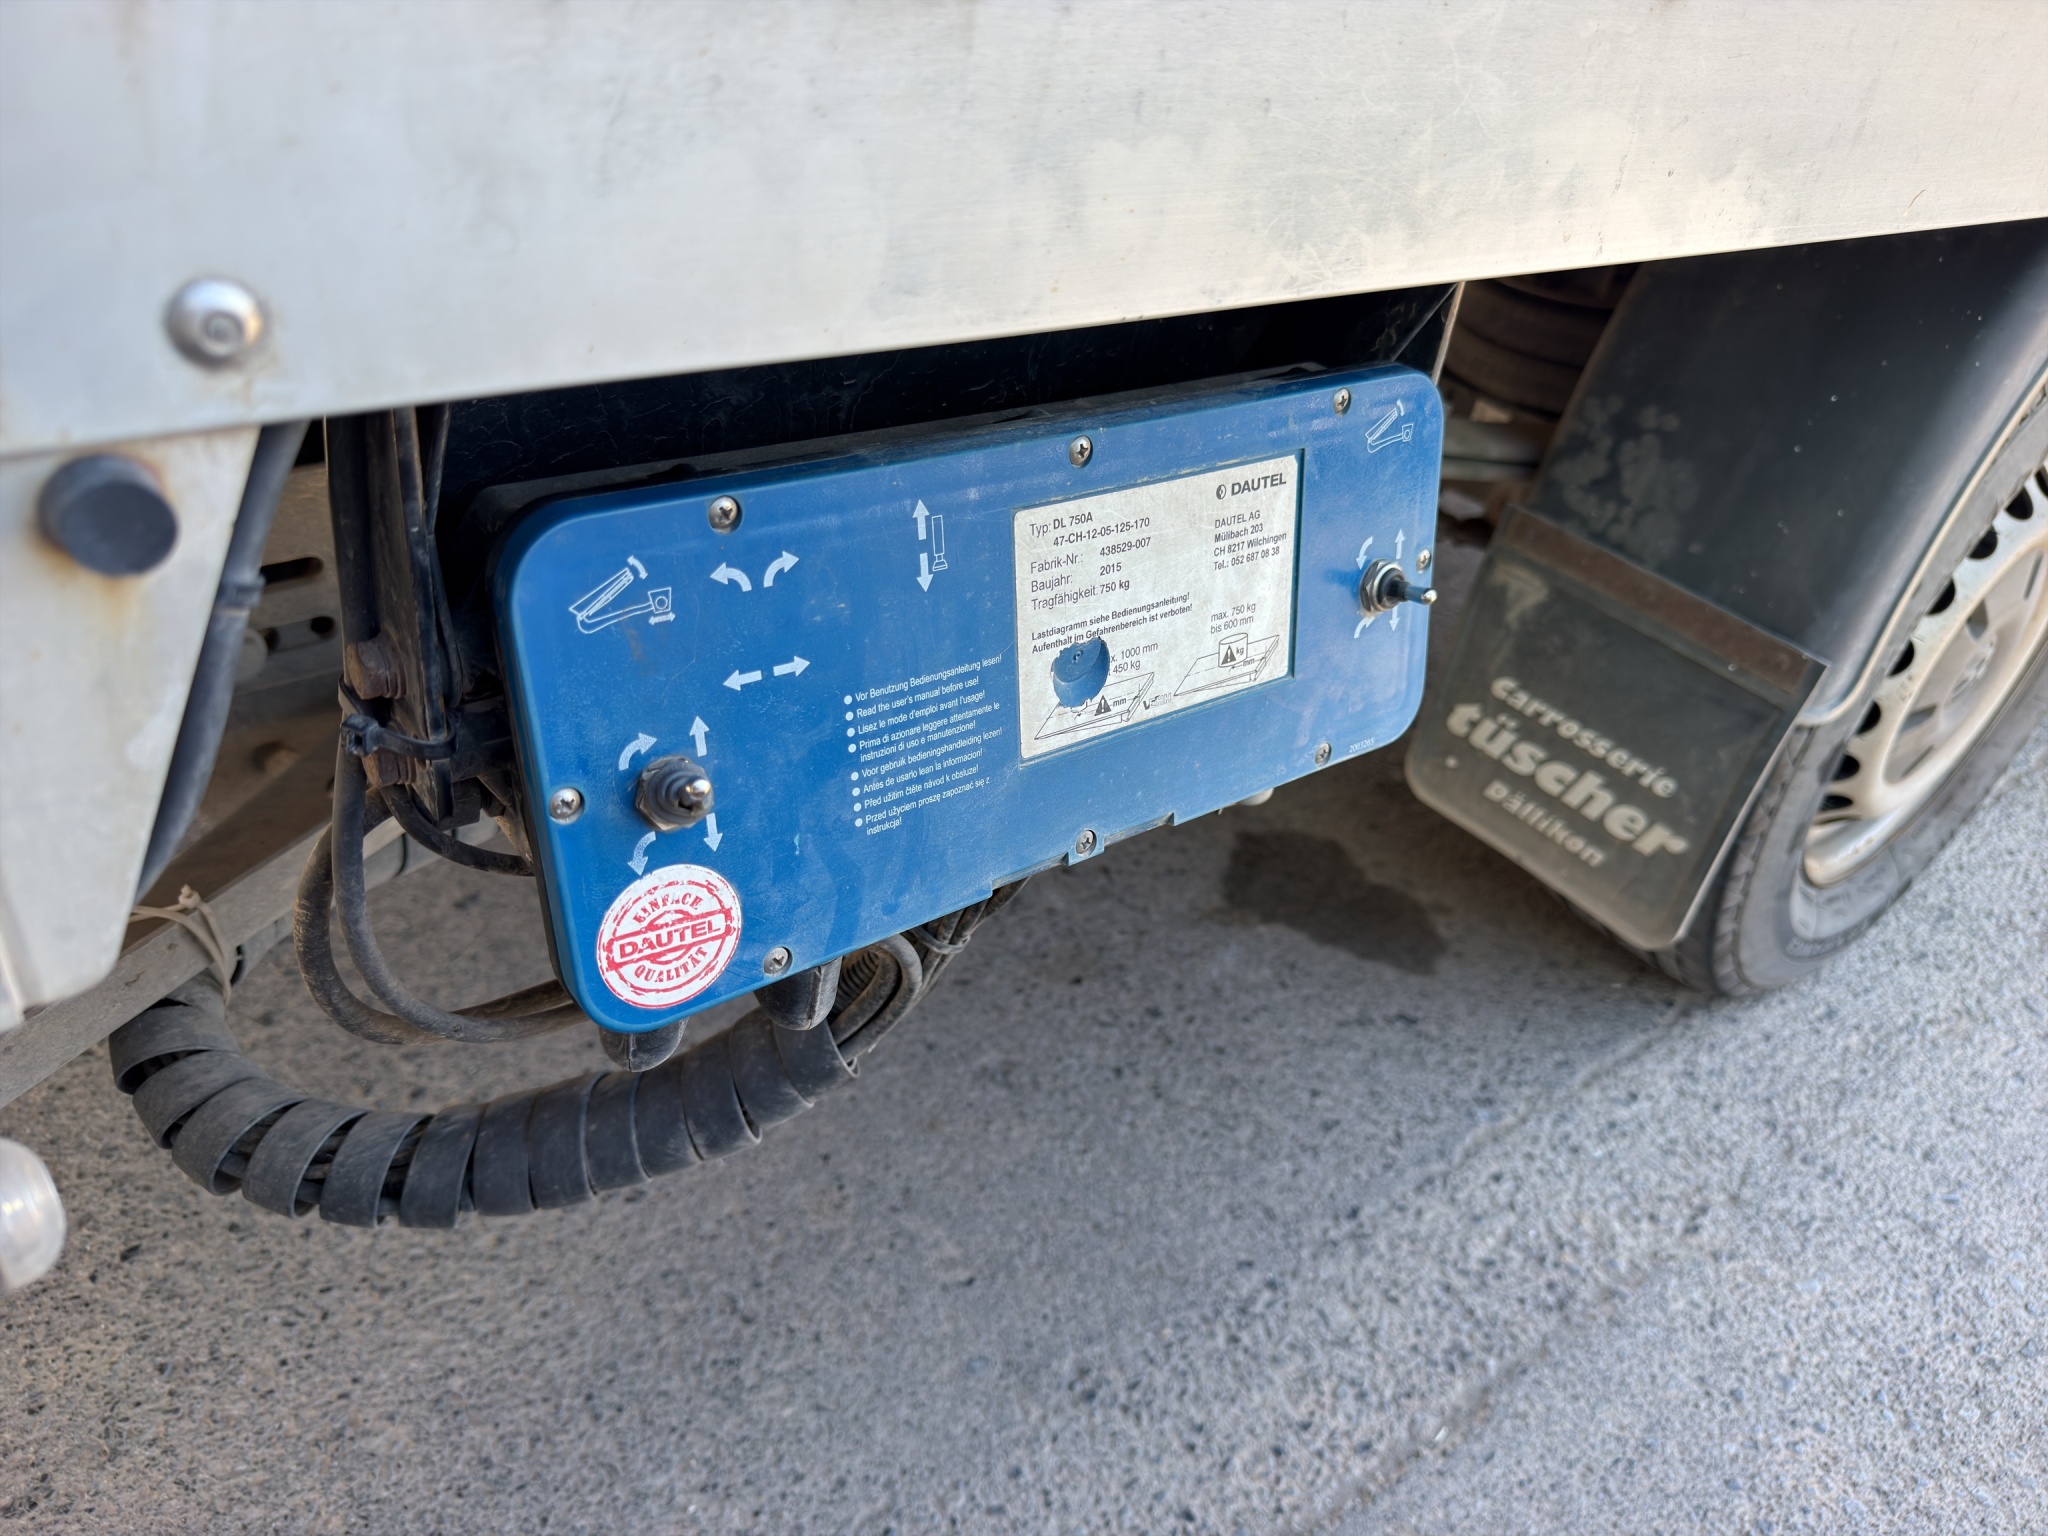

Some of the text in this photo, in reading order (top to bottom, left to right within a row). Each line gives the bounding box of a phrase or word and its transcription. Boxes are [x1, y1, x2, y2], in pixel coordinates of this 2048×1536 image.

[1231, 473, 1287, 496] DAUTEL
[1030, 511, 1093, 538] Typ: DL 750A
[1053, 517, 1150, 547] 47-CH-12-05-125-170
[1214, 523, 1263, 543] Mülibach 203
[1215, 510, 1260, 529] DAUTEL AG
[1030, 537, 1151, 574] Fabrik-Nr.: 438529-007
[1214, 533, 1287, 557] CH 8217 Wilchingen
[1214, 546, 1280, 570] Tel.: 052 687 08 38
[1031, 562, 1122, 593] Baujahr: 2015
[1032, 579, 1130, 611] Tragfähigkeit: 750 kg
[1032, 592, 1190, 641] Lastdiagramm siehe Bedienungsanleitung!
[1210, 603, 1256, 622] max. 750 kg
[1210, 616, 1254, 634] bis 600 mm
[1032, 604, 1193, 654] Aufenthalt im Gefahrenbereich ist verboten!
[1121, 647, 1140, 660] 1000
[1142, 642, 1158, 654] mm
[1236, 646, 1245, 655] kg
[855, 654, 1002, 702] Vor Benutzung Bedienungsanleitung lesen!
[1113, 661, 1129, 674] 450
[1130, 659, 1141, 670] kg
[857, 676, 979, 718] Read the user's manual before use!
[1112, 697, 1127, 708] mm
[858, 690, 985, 735] Lisez le mode d'emploi avant l'usage!
[860, 702, 1000, 751] Prima di azionare leggere attentamente le
[860, 745, 897, 763] instruzioni
[898, 742, 905, 751] di
[906, 738, 919, 749] uso
[927, 720, 976, 742] manutenzione!
[861, 727, 1003, 778] Voor gebruik bedieningshandleiding lezen!
[863, 781, 884, 794] Antes
[886, 777, 895, 786] de
[919, 765, 933, 776] lean
[935, 762, 942, 771] la
[924, 775, 944, 789] návod
[946, 774, 950, 782] k
[1446, 703, 1689, 856] tüscher
[866, 810, 887, 824] Przed
[867, 817, 902, 836] instrukcja!
[619, 919, 721, 959] DAUTEL
[634, 946, 708, 983] QUALITÄT
